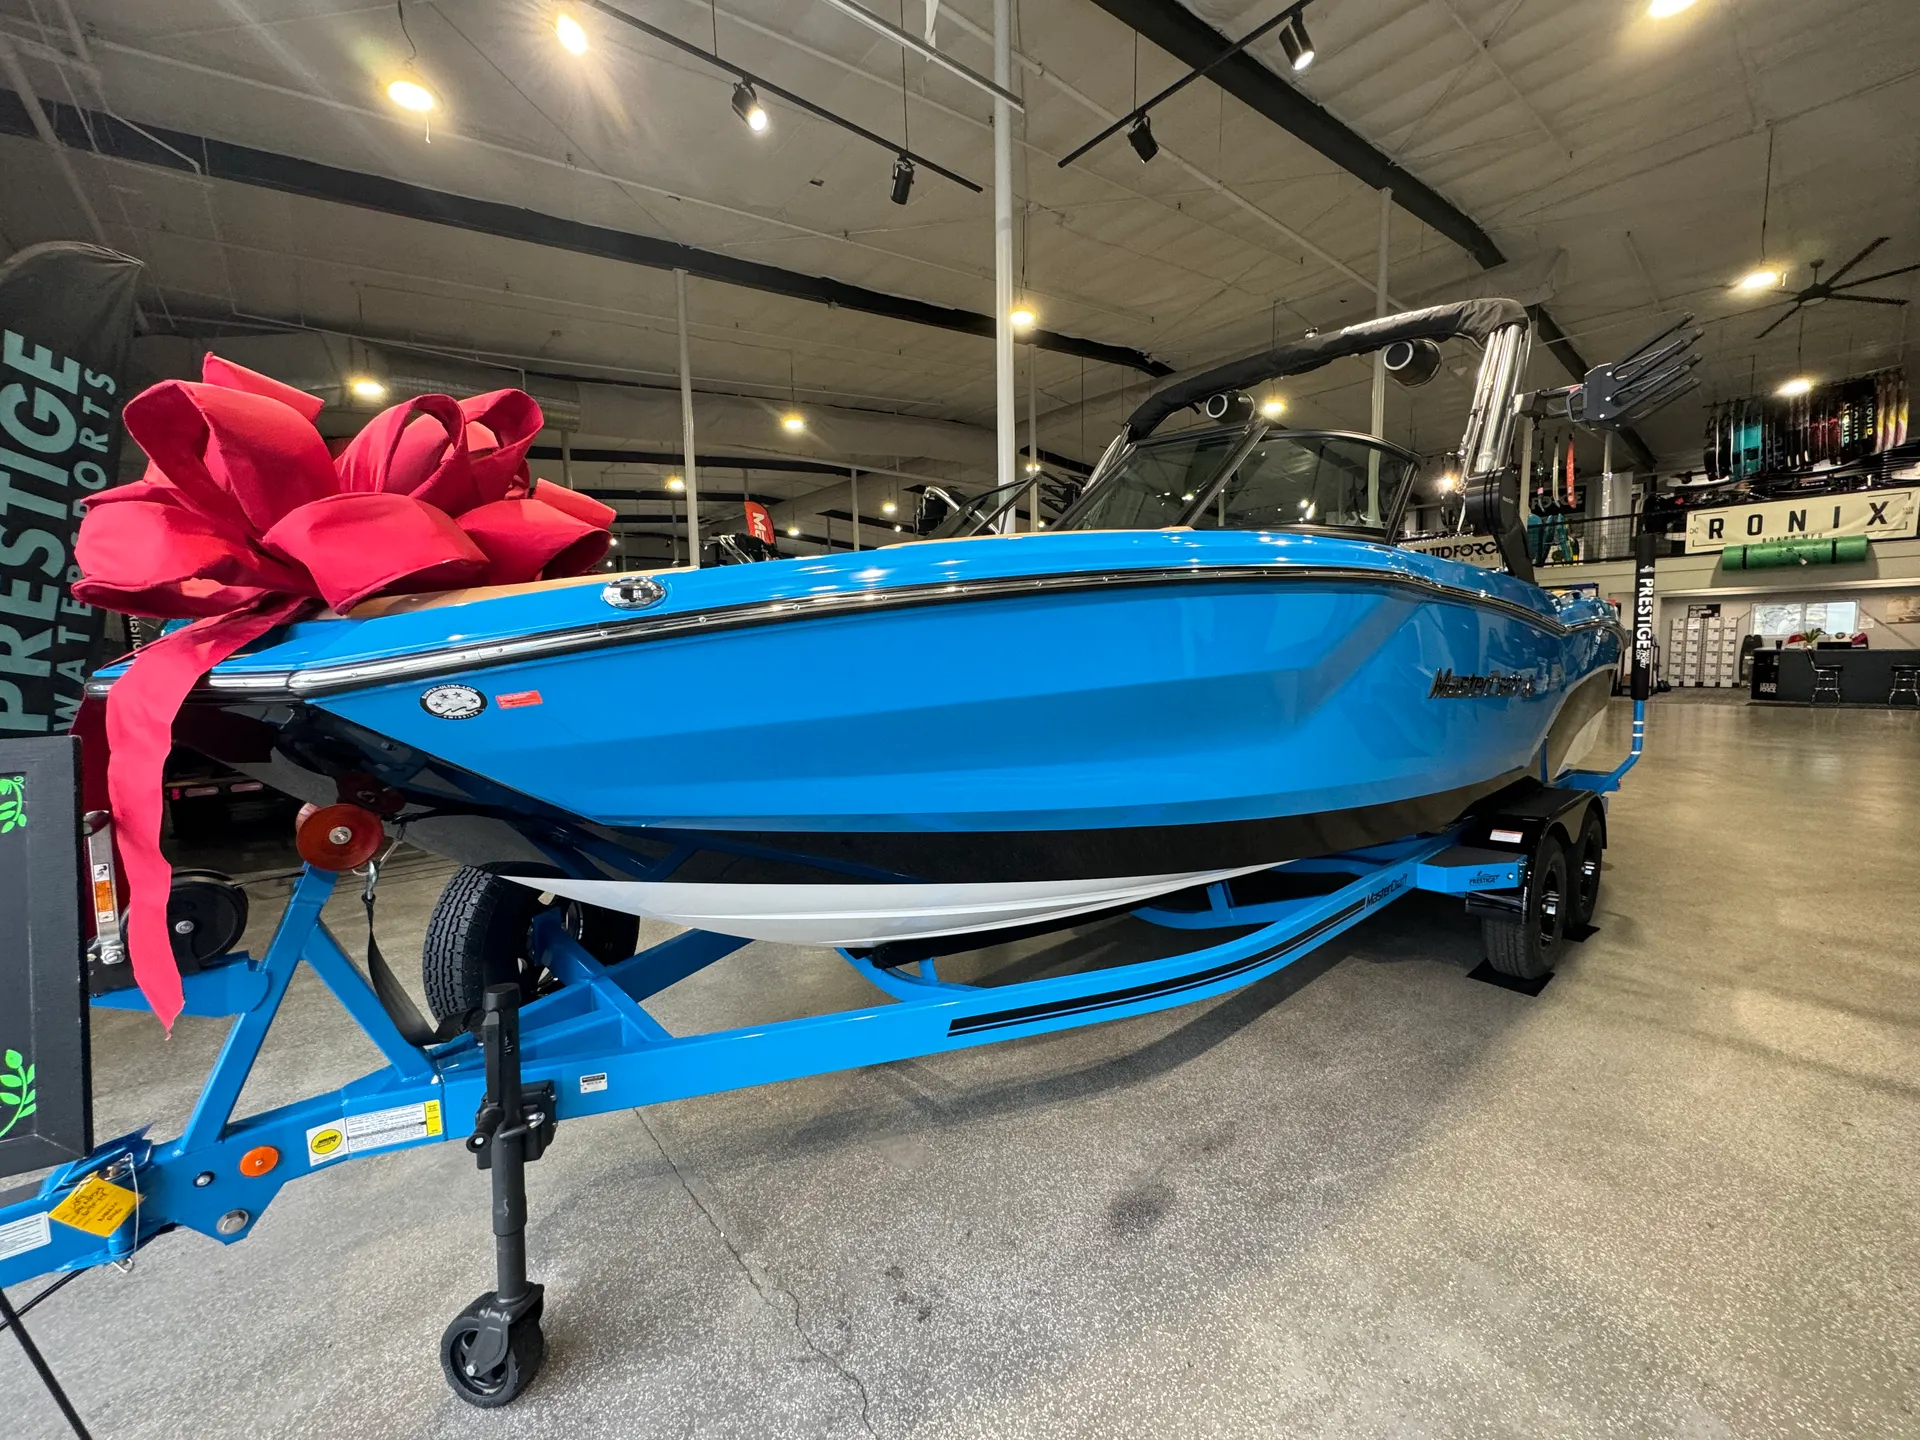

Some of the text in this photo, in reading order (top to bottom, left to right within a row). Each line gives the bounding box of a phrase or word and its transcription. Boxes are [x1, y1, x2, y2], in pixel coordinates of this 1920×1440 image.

[0, 328, 81, 732] PRESTIGE
[53, 367, 116, 732] WATERPORTS
[1636, 578, 1654, 649] PRESTIGE
[1708, 500, 1890, 540] RONIX
